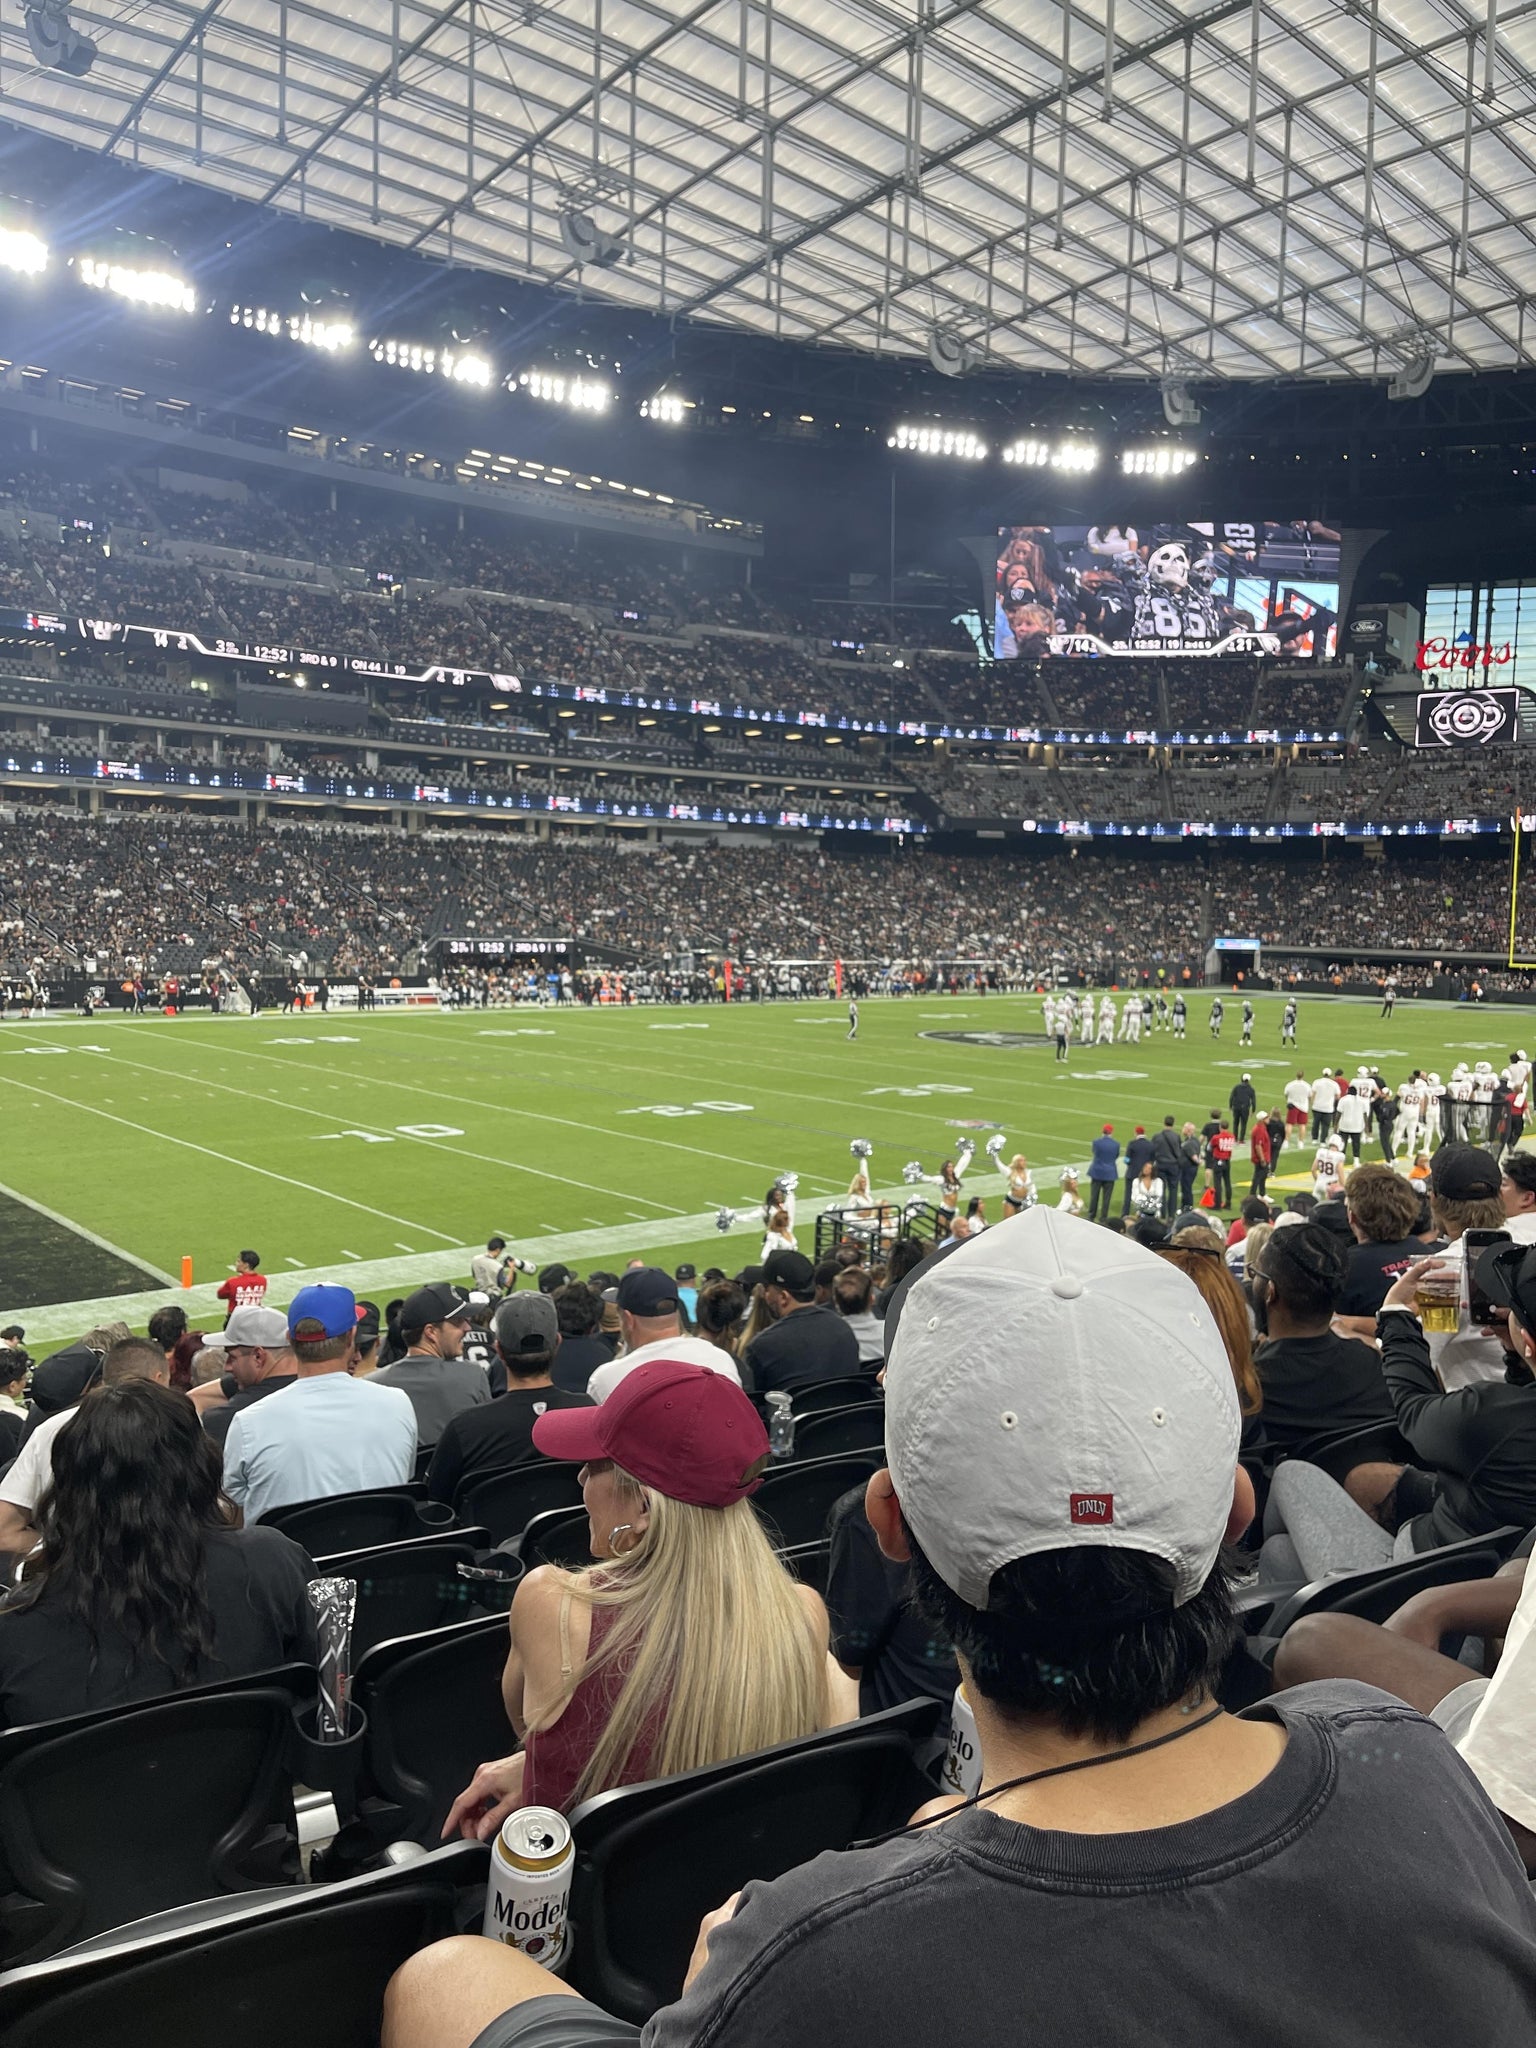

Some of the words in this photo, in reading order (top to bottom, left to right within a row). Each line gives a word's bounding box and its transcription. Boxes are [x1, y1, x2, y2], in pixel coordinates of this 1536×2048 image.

[254, 646, 288, 662] 12:52
[300, 652, 318, 665] 3RD
[330, 656, 337, 667] 9
[351, 659, 367, 671] ON
[367, 662, 381, 673] 44
[1415, 637, 1511, 671] Coors
[478, 942, 505, 953] 12:52
[1358, 1087, 1370, 1098] 12
[342, 1123, 466, 1144] 10
[1381, 1259, 1411, 1274] TRAC
[1077, 1500, 1106, 1516] UNLV
